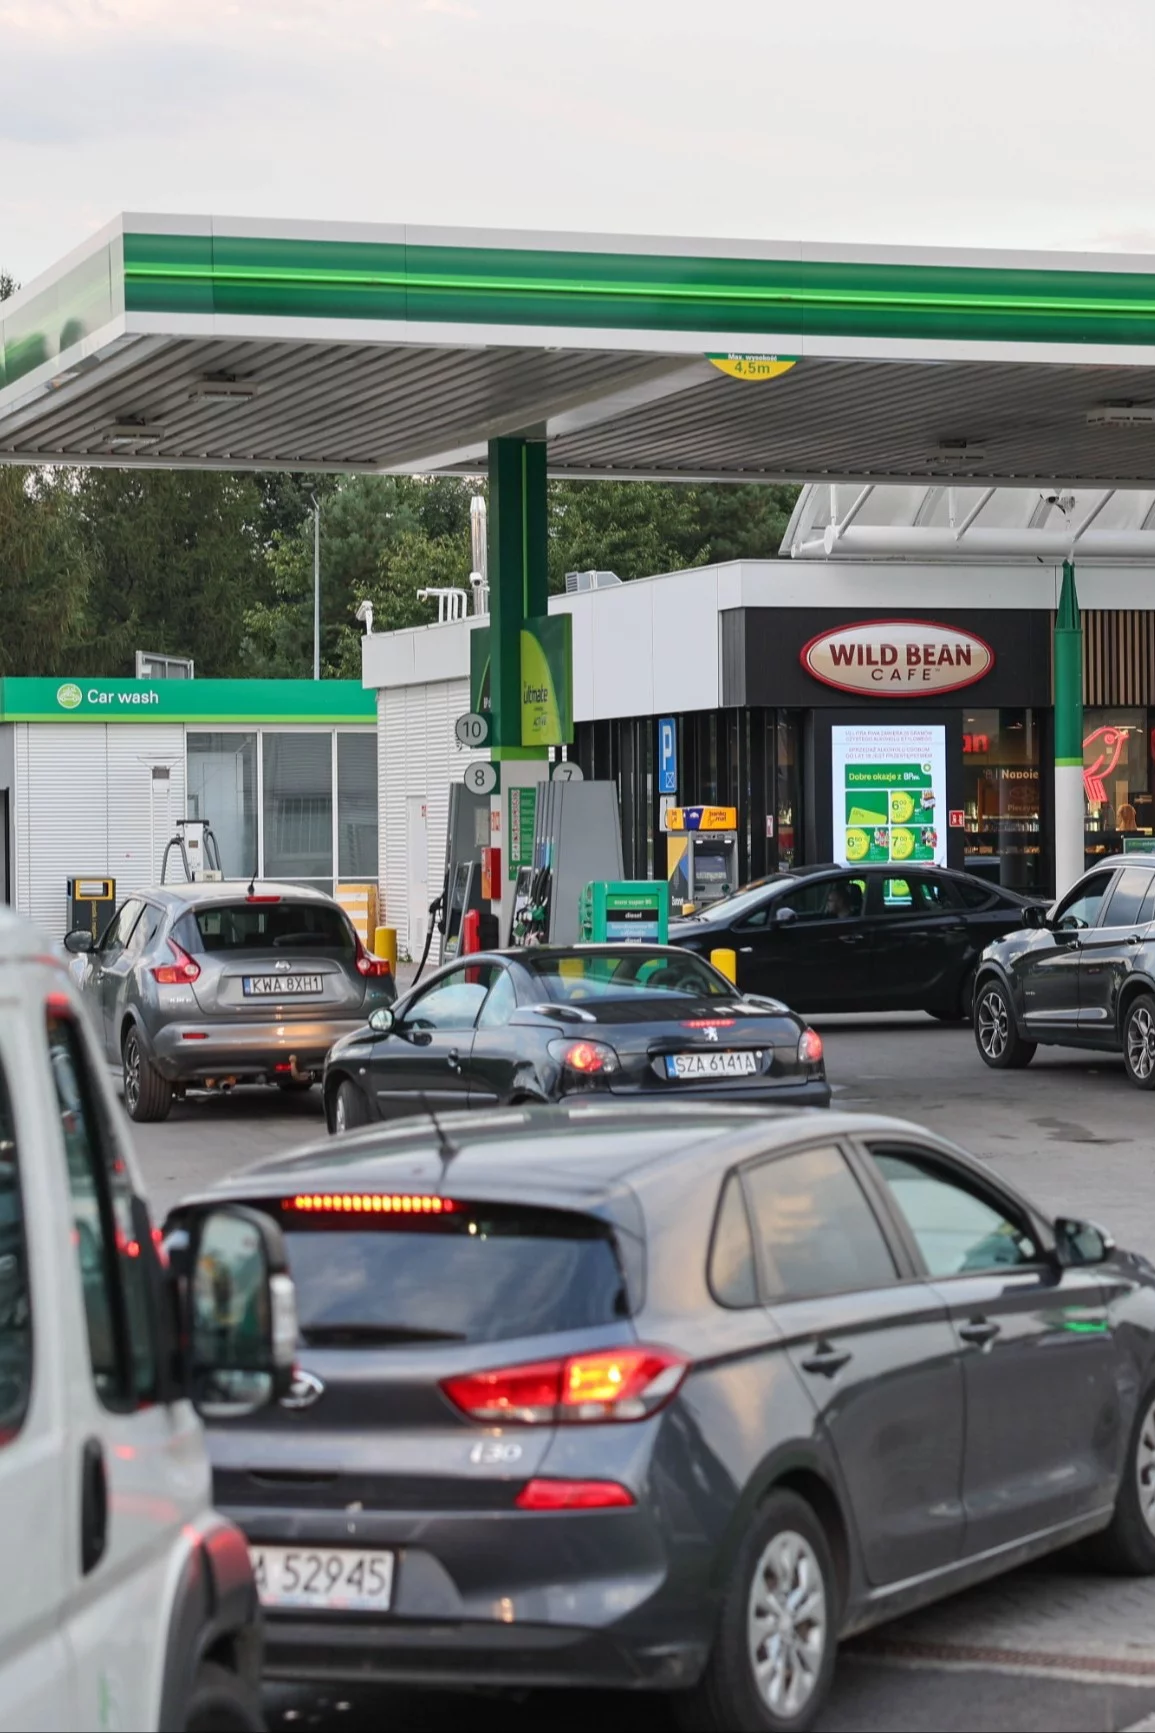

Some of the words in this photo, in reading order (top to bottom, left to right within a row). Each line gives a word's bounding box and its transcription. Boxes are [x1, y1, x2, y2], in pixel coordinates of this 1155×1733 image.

[735, 361, 770, 375] 4,5m
[829, 644, 898, 666] WILD
[907, 644, 971, 666] BEAN
[871, 668, 931, 681] CAFE
[87, 689, 114, 703] Car
[118, 690, 159, 704] wash
[463, 721, 481, 738] 10
[662, 725, 672, 771] P
[475, 769, 485, 787] 8
[849, 773, 871, 781] Dobre
[873, 773, 896, 782] okazje
[253, 976, 281, 993] KWA
[287, 976, 318, 991] 8XH1
[676, 1053, 705, 1073] SZA
[710, 1051, 754, 1070] 6141A
[282, 1553, 386, 1596] 52945
